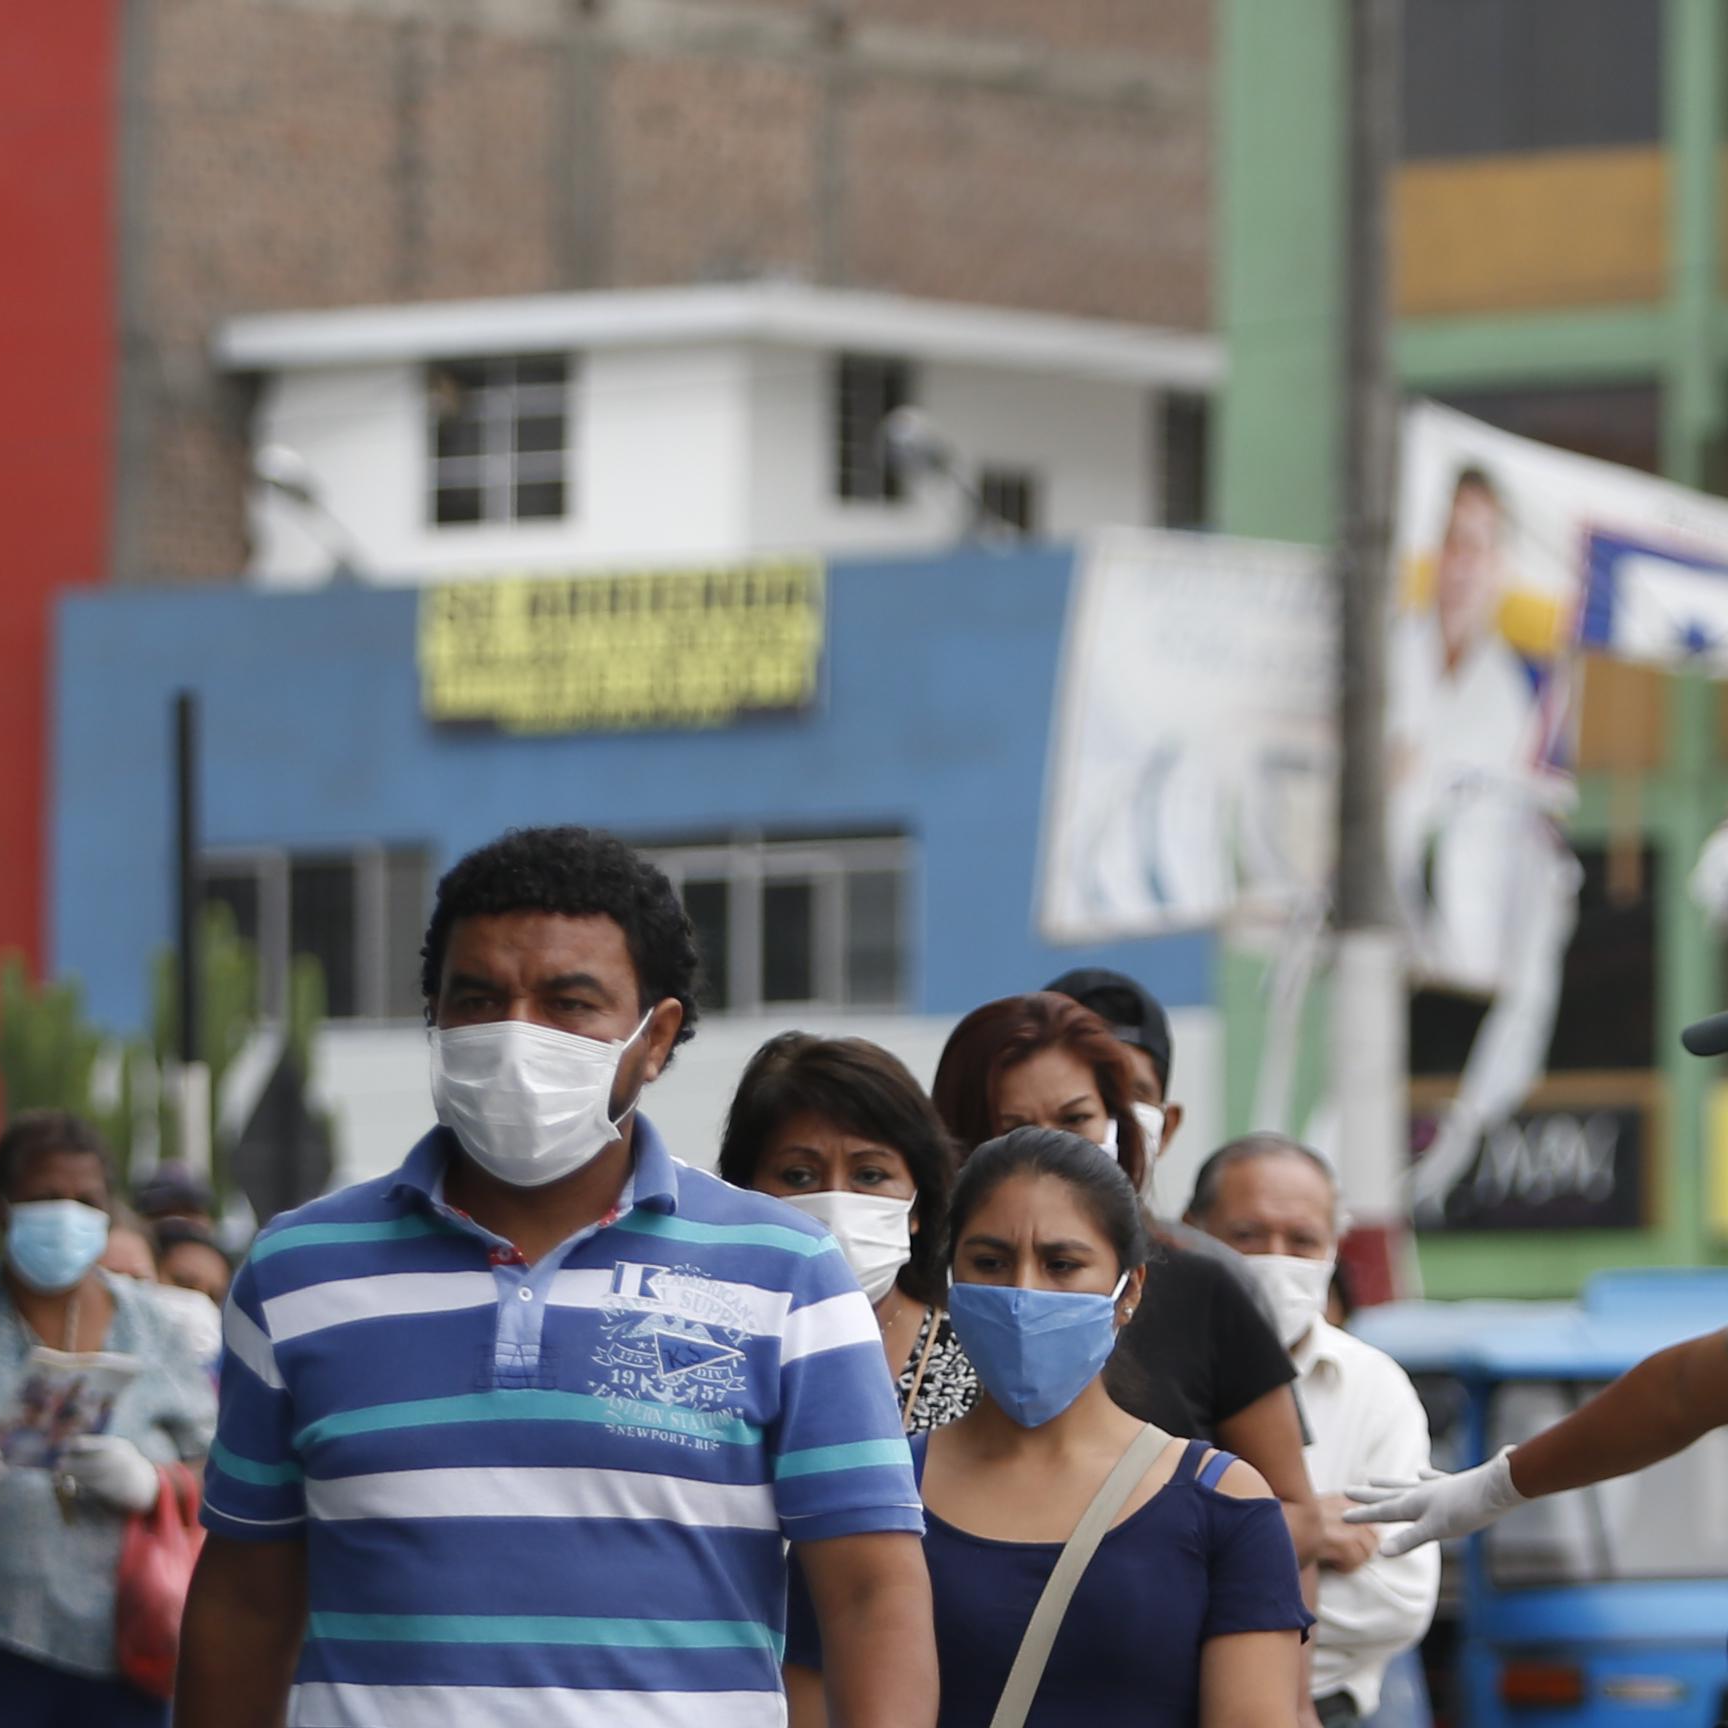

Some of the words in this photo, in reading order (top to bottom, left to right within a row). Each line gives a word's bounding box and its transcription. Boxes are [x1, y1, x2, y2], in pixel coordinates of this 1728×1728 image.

[680, 1290, 752, 1347] SUPPLY
[611, 1368, 636, 1385] 19
[696, 1367, 724, 1380] DIV
[700, 1385, 728, 1402] 57
[593, 1384, 665, 1424] EASTERN
[671, 1407, 736, 1431] STATION
